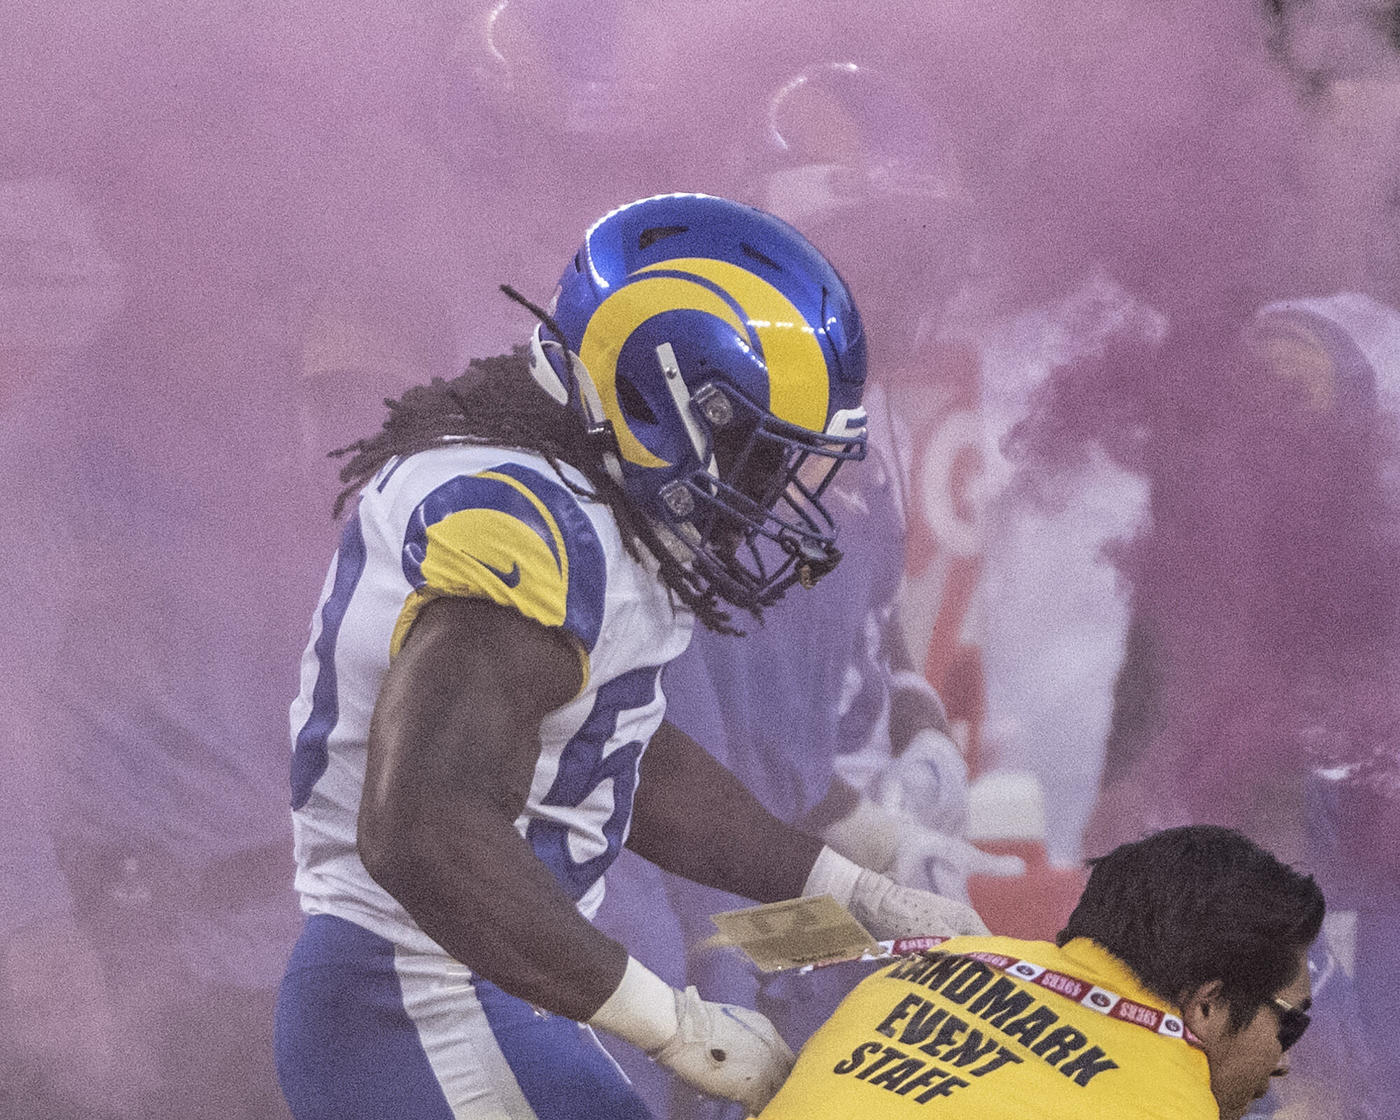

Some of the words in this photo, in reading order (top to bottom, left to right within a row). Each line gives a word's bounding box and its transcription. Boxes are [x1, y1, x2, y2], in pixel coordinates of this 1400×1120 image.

[875, 993, 1024, 1077] EVENT
[885, 951, 1120, 1088] LANDMARK
[834, 1041, 970, 1104] STAFF
